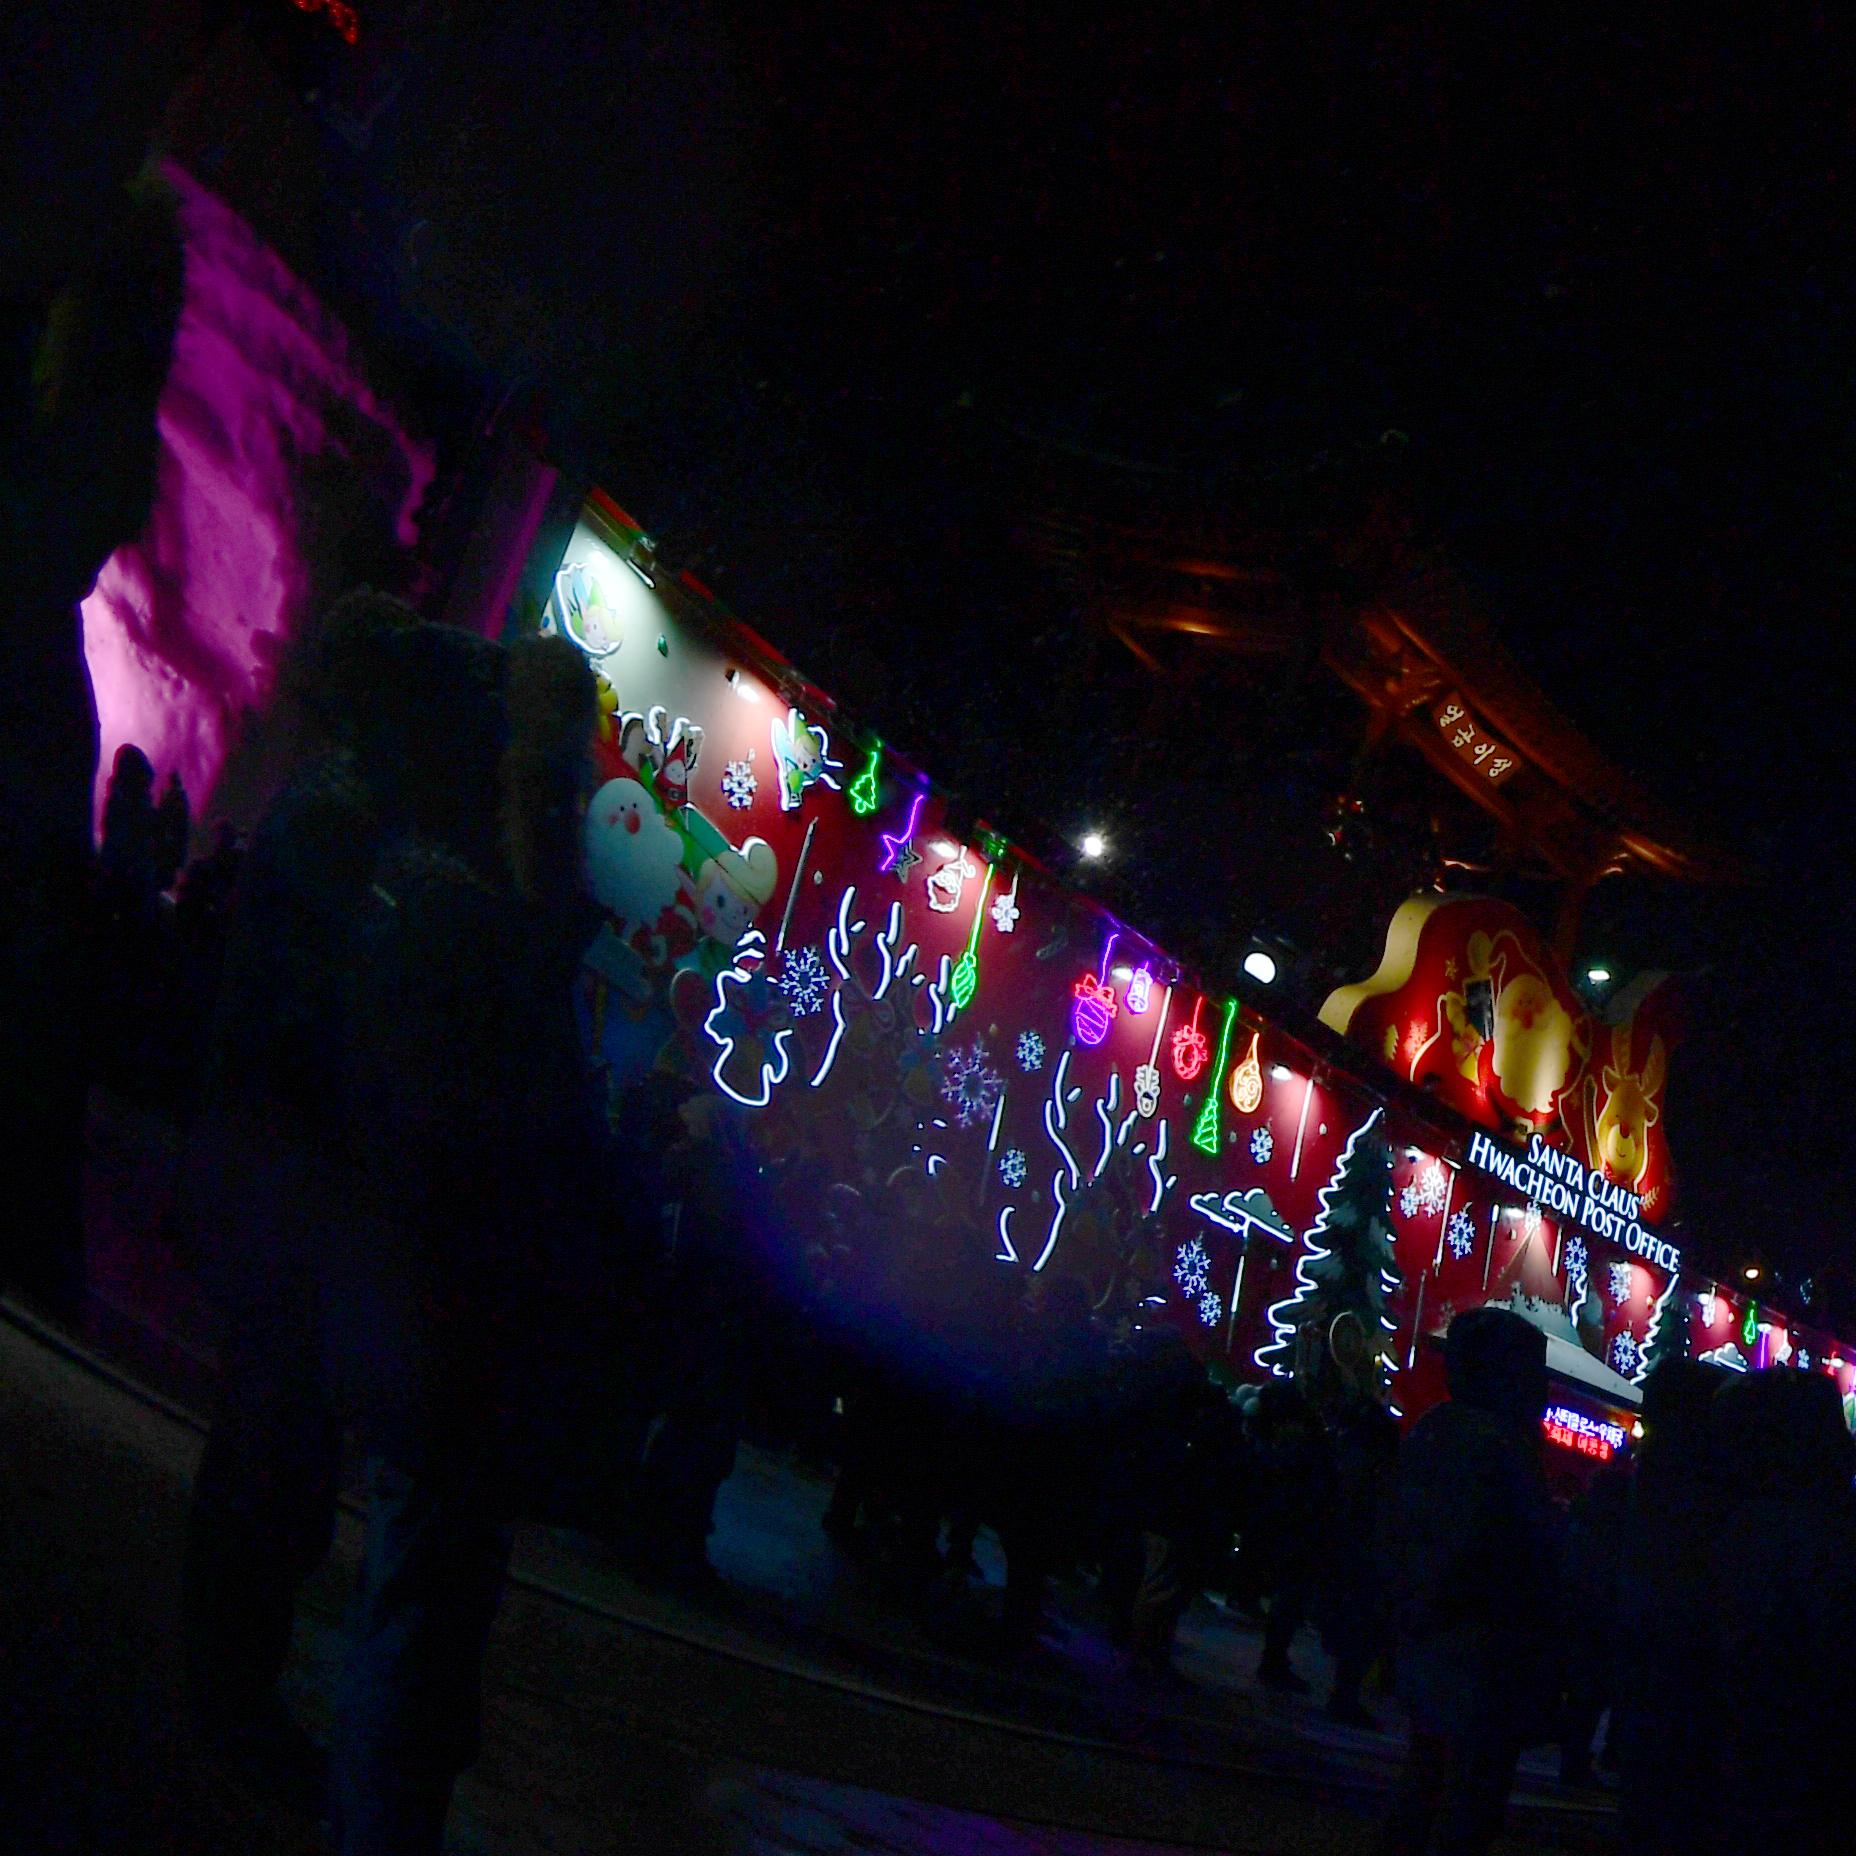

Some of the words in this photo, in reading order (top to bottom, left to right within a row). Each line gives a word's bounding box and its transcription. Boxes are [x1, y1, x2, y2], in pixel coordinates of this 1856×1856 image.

[1440, 705, 1512, 777] 얼곰이성
[1528, 1133, 1583, 1191] SANTA
[1468, 1132, 1580, 1218] HWACHEON
[1581, 1196, 1625, 1242] POST
[1626, 1223, 1680, 1272] OFFICE
